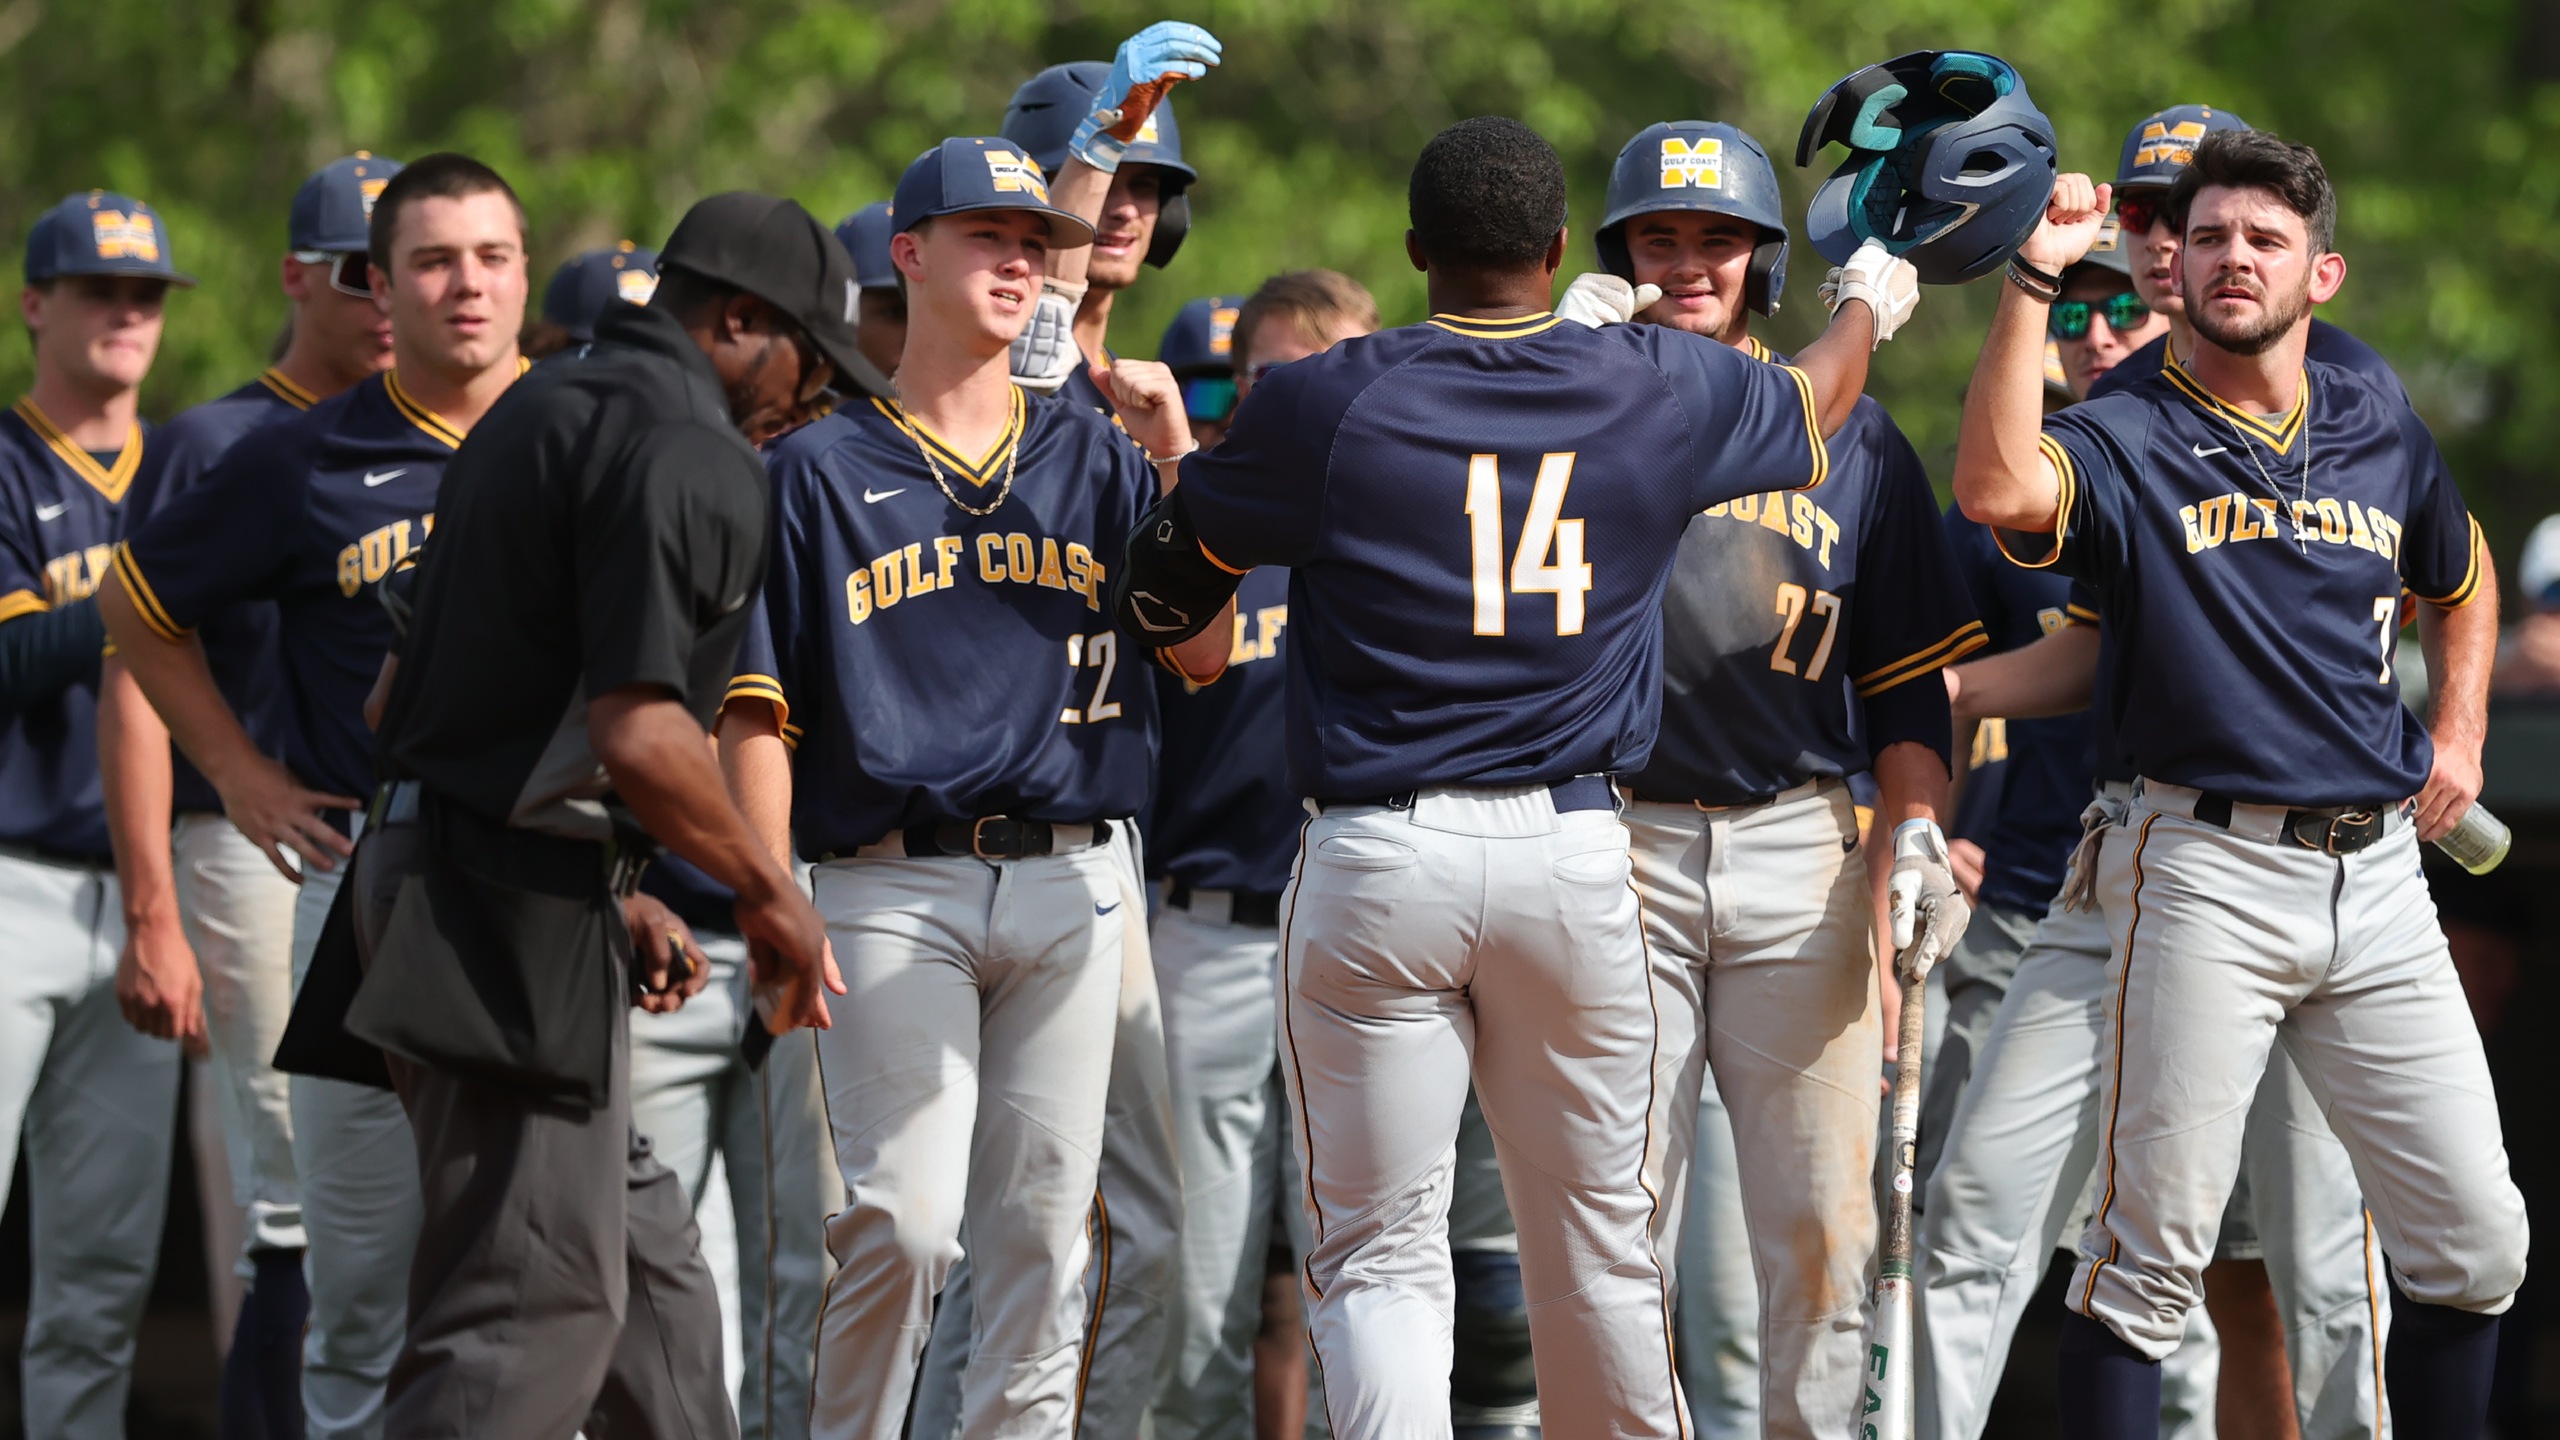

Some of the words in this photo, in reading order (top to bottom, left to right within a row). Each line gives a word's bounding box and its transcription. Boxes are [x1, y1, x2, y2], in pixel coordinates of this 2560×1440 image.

[1661, 137, 1722, 189] M
[1664, 158, 1687, 166] GULF
[1689, 158, 1718, 166] COAST
[337, 511, 436, 598] GUL
[1464, 451, 1593, 637] 14
[2178, 492, 2279, 554] GULF
[2291, 497, 2402, 574] COAST
[846, 535, 964, 625] GULF
[976, 532, 1105, 613] COAST
[1770, 582, 1842, 682] 27
[2373, 597, 2396, 684] 7
